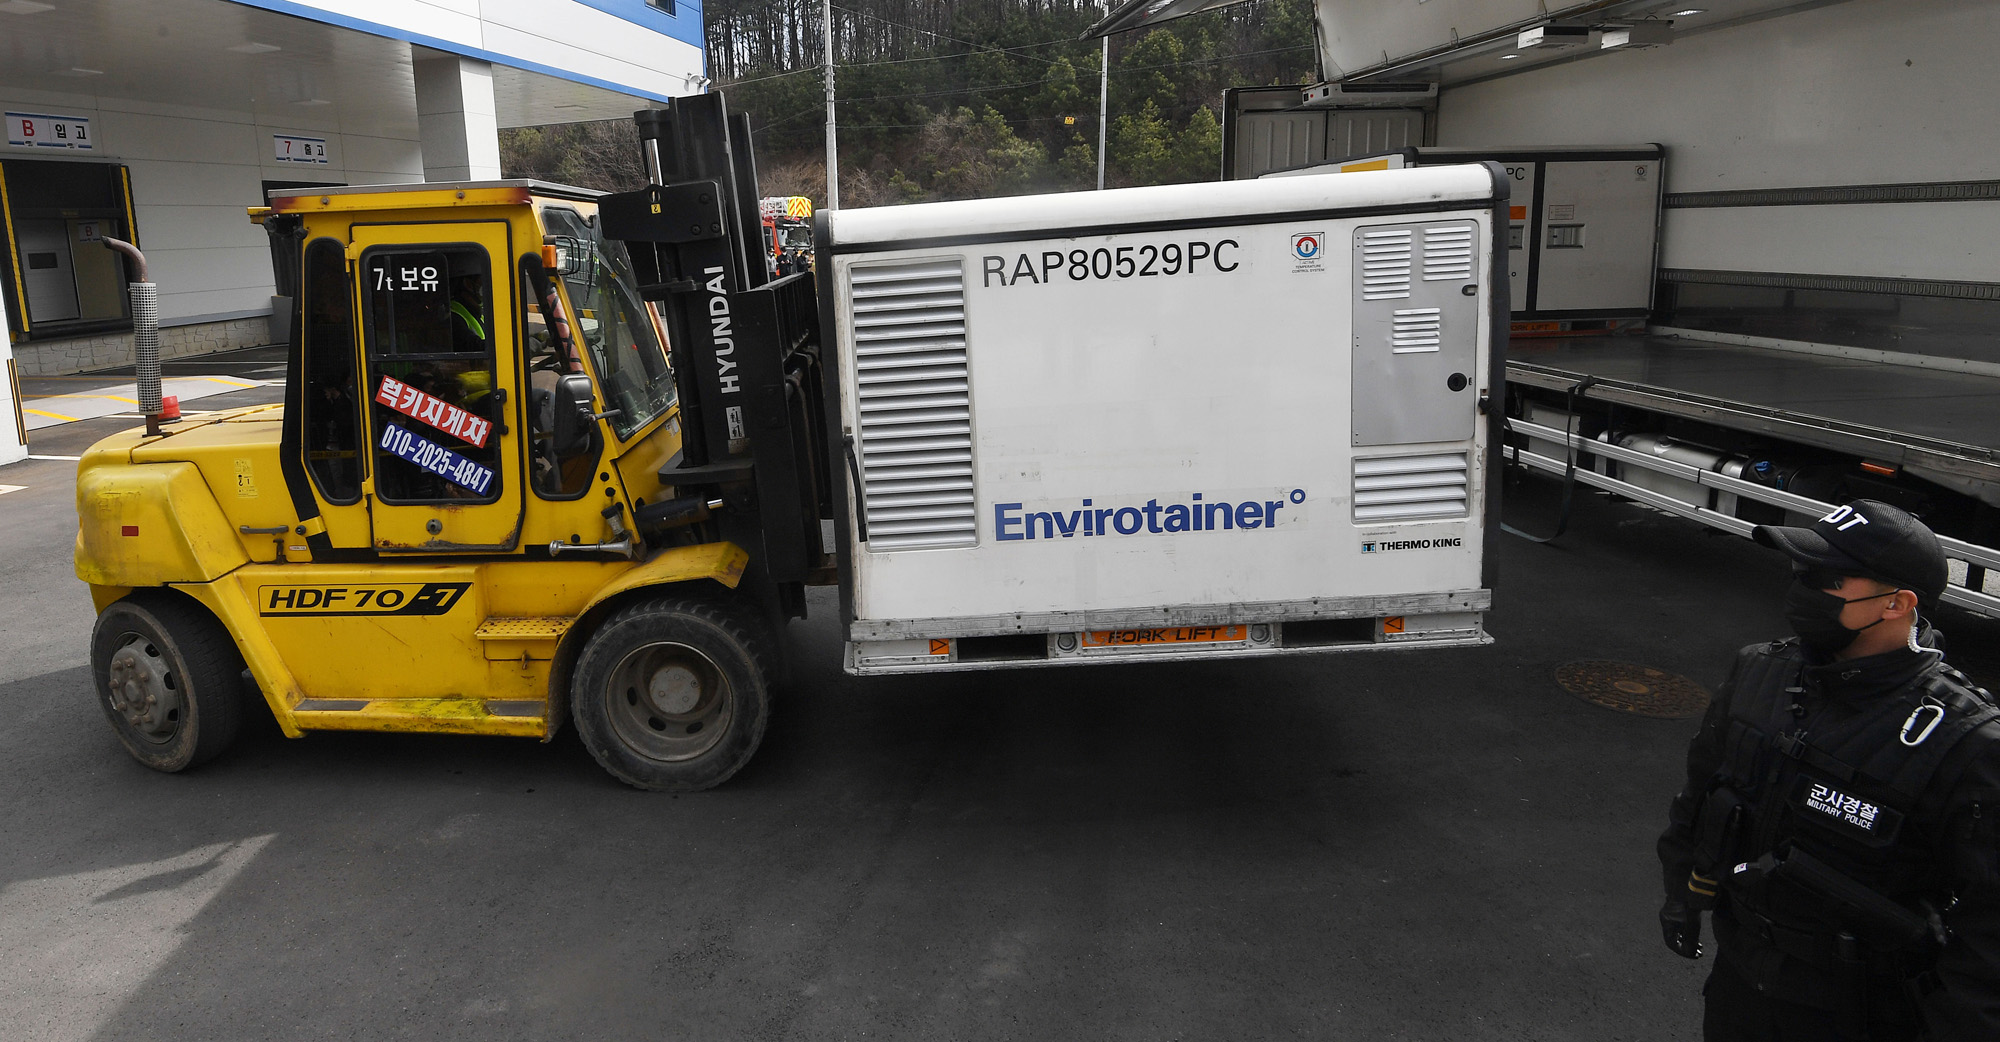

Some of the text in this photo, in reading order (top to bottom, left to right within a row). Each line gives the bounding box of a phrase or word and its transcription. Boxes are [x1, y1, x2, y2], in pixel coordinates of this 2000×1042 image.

[22, 119, 35, 137] B
[284, 140, 292, 154] 7
[982, 239, 1240, 288] RAP80529PC
[373, 266, 439, 292] 7t 보유
[703, 265, 741, 394] HYUNDAI
[380, 377, 488, 446] 럭키지게차
[381, 424, 493, 493] 010-2025-4847
[994, 492, 1284, 542] Envirotainer
[1818, 504, 1869, 532] DT
[1379, 539, 1431, 551] THERMO
[1432, 537, 1461, 548] KING
[269, 588, 348, 609] HDF
[1107, 626, 1222, 644] FORK LIFT
[1806, 798, 1873, 831] MILITARY POLICE
[1810, 783, 1879, 821] 군사경찰
